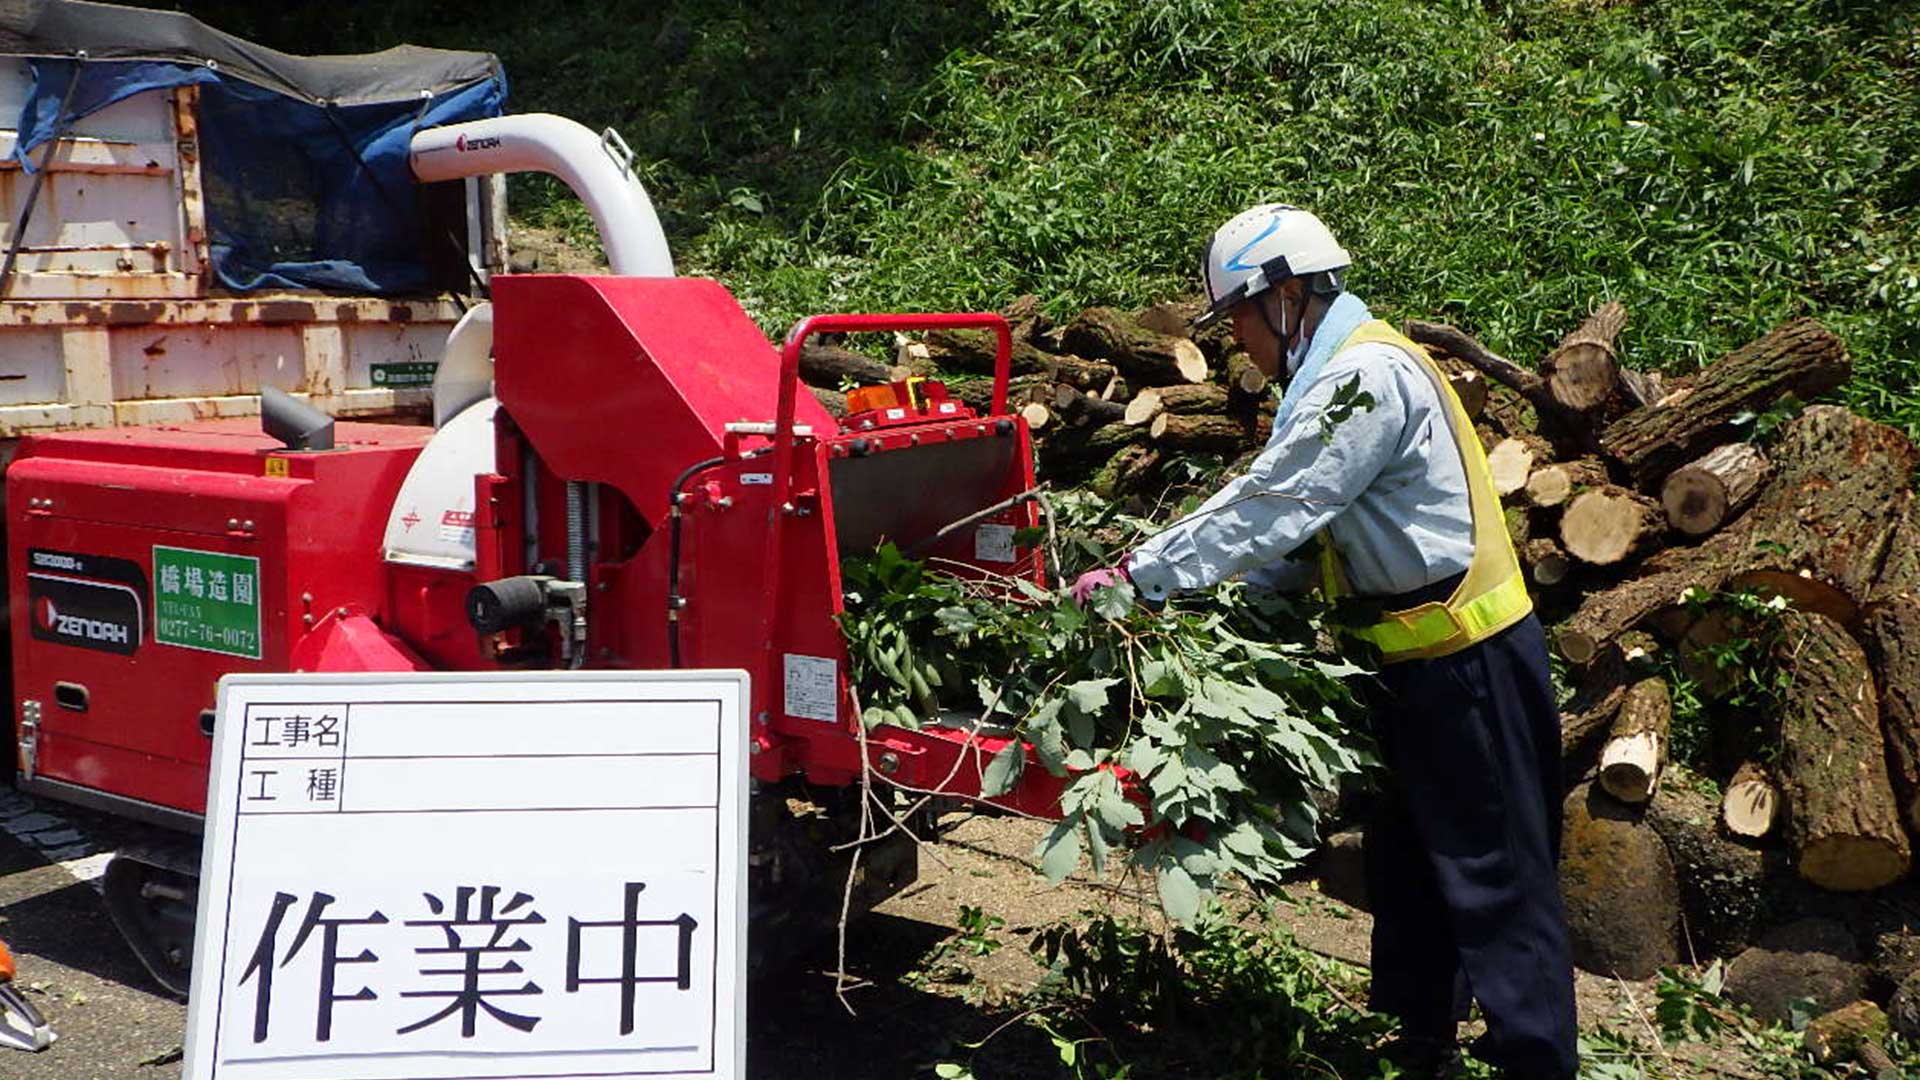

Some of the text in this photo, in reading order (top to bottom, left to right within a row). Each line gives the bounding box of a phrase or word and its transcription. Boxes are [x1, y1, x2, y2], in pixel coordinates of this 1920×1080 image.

[160, 564, 253, 606] 橋場造園
[55, 614, 128, 644] ZENOAH
[160, 618, 255, 650] 0277-76-0072
[251, 713, 341, 749] 工事名
[237, 881, 698, 1044] 作業中
